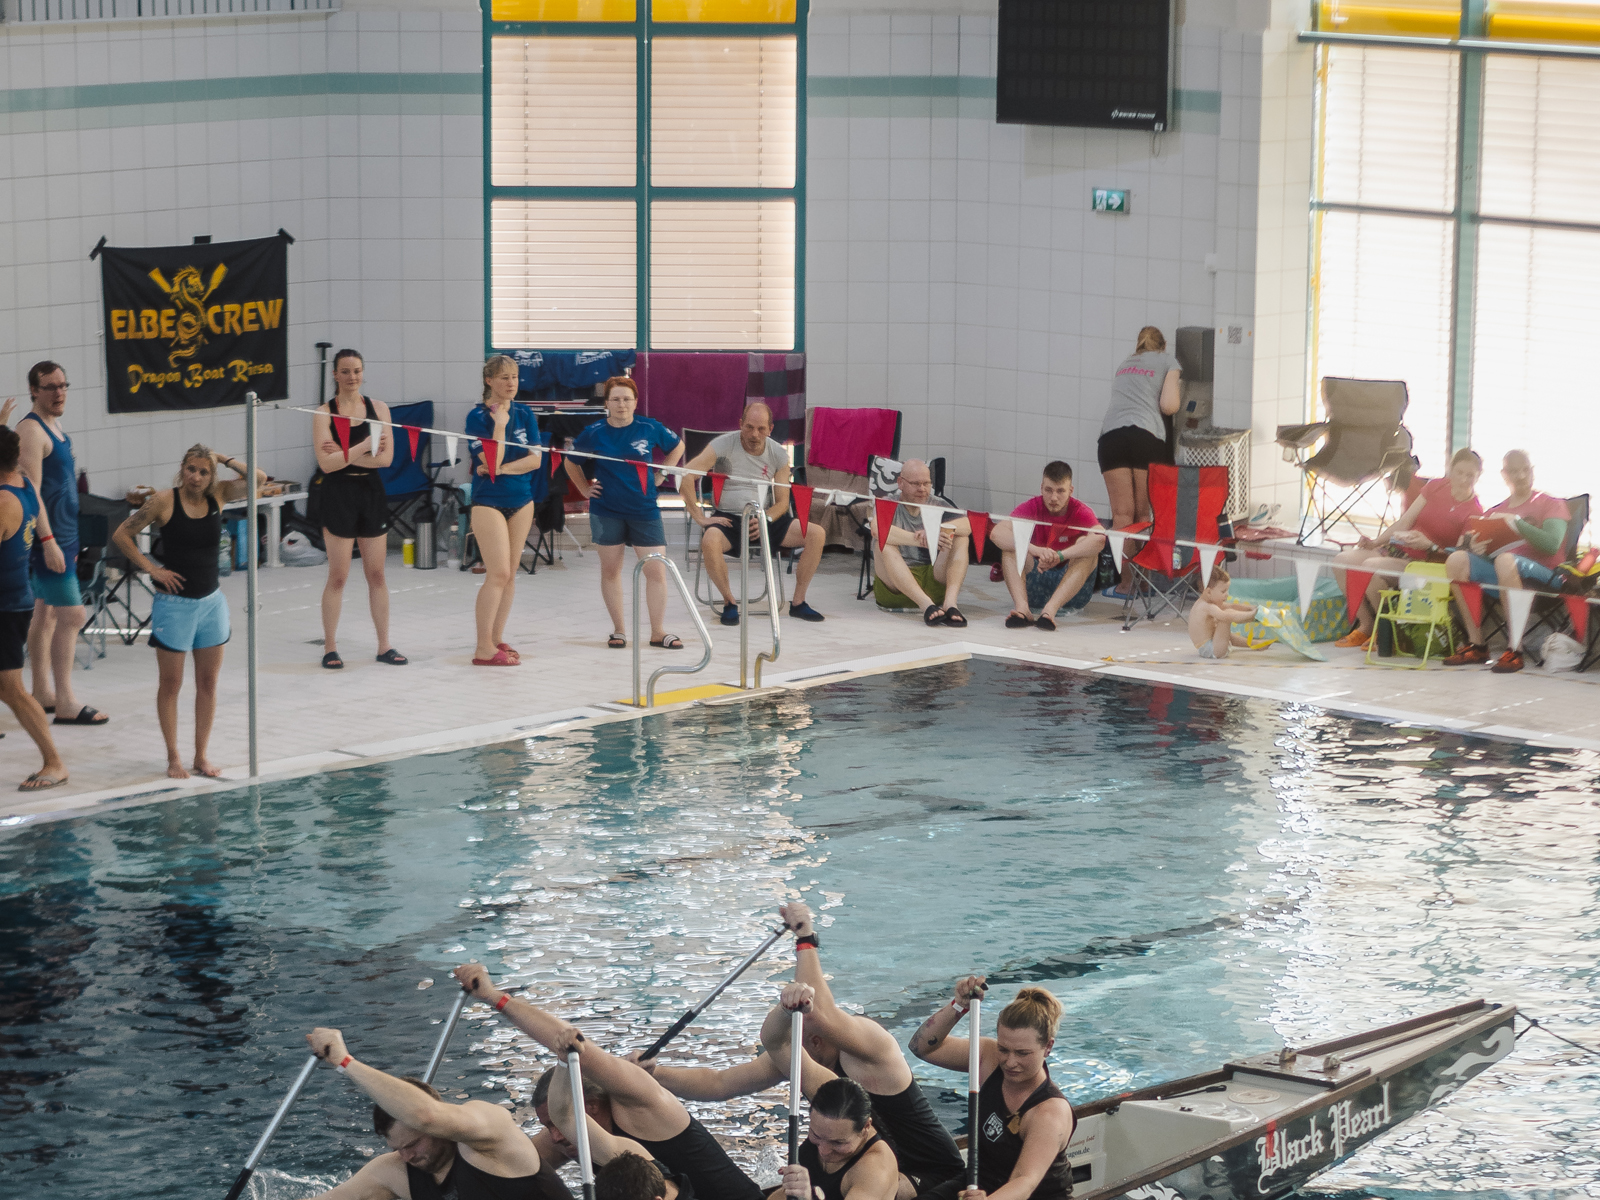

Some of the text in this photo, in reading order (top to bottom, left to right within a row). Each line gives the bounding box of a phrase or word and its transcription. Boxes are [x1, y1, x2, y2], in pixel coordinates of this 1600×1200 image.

[111, 298, 283, 340] ELBE CREW
[127, 359, 274, 393] Dragon Boat Riesa
[1116, 366, 1155, 377] anthers
[1065, 1146, 1091, 1158] ragon.de
[1255, 1081, 1392, 1194] Black Pearl
